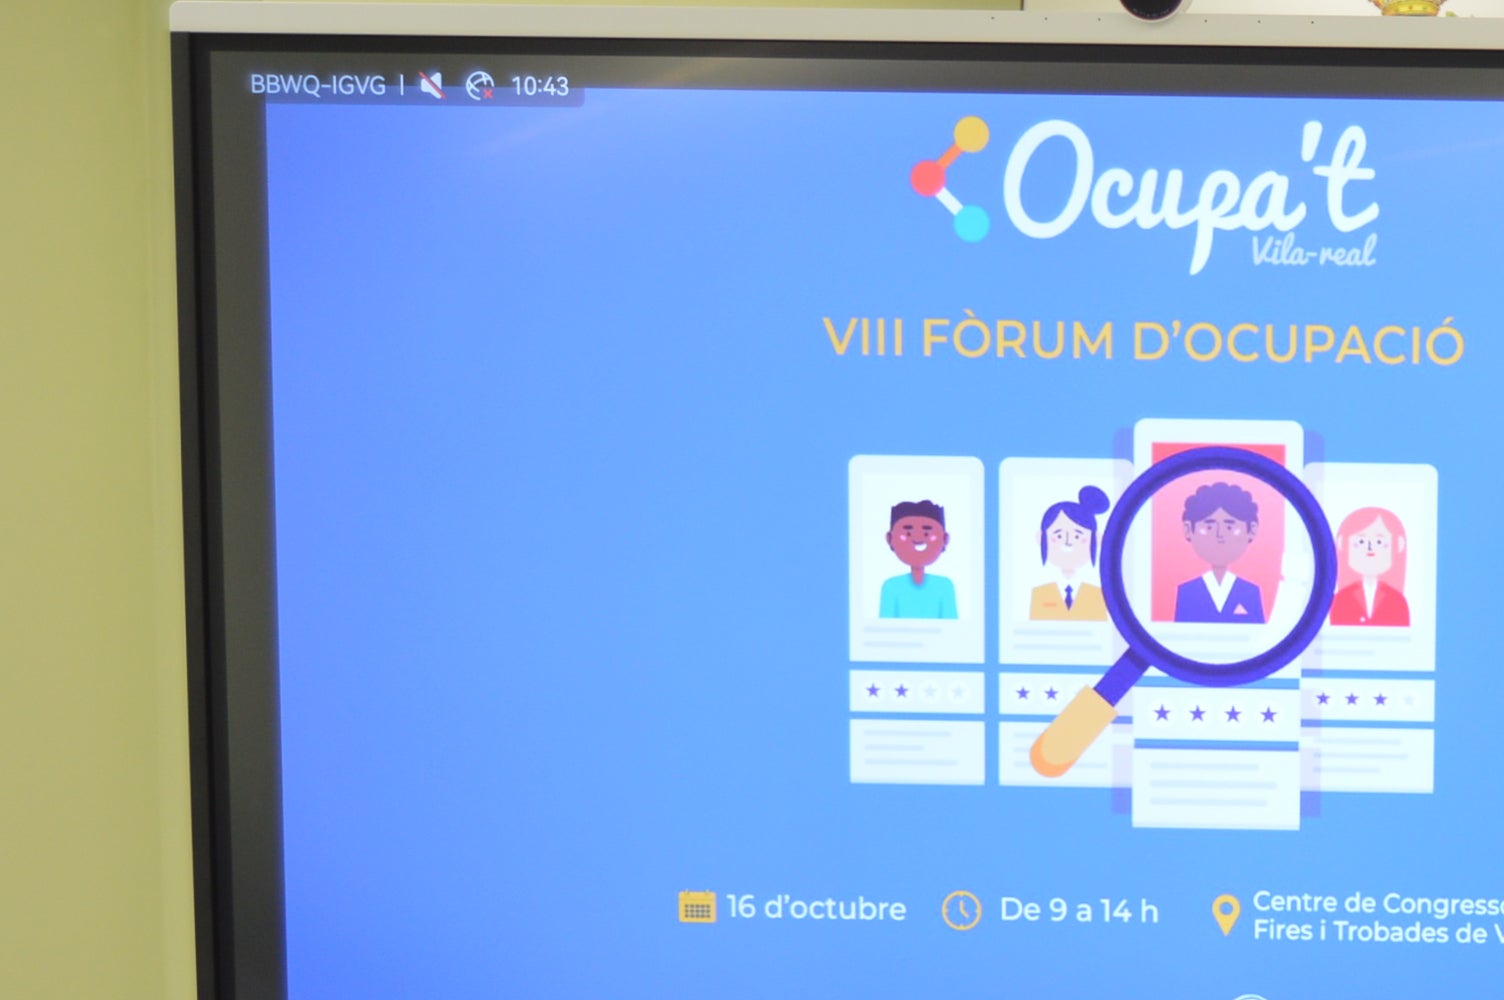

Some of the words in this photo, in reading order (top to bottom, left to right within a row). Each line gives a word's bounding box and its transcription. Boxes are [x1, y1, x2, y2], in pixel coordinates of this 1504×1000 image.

[250, 73, 386, 97] BBWQ-IGVG
[511, 75, 569, 97] 10:43
[1004, 120, 1379, 275] Ocupa't
[1252, 232, 1377, 267] Vila-real
[823, 316, 903, 356] VIII
[922, 308, 1114, 360] FÒRUM
[1133, 316, 1466, 366] D'OCUPACIÓ
[727, 894, 756, 918] 16
[765, 895, 907, 920] d'octubre
[1001, 897, 1041, 921] De
[1050, 898, 1067, 922] 9
[1076, 904, 1092, 922] a
[1101, 899, 1132, 923] 14
[1141, 898, 1158, 923] h
[1253, 890, 1338, 912] Centre
[1344, 891, 1377, 913] de
[1254, 919, 1313, 941] Fires
[1334, 920, 1449, 944] Trobades
[1455, 922, 1488, 945] de
